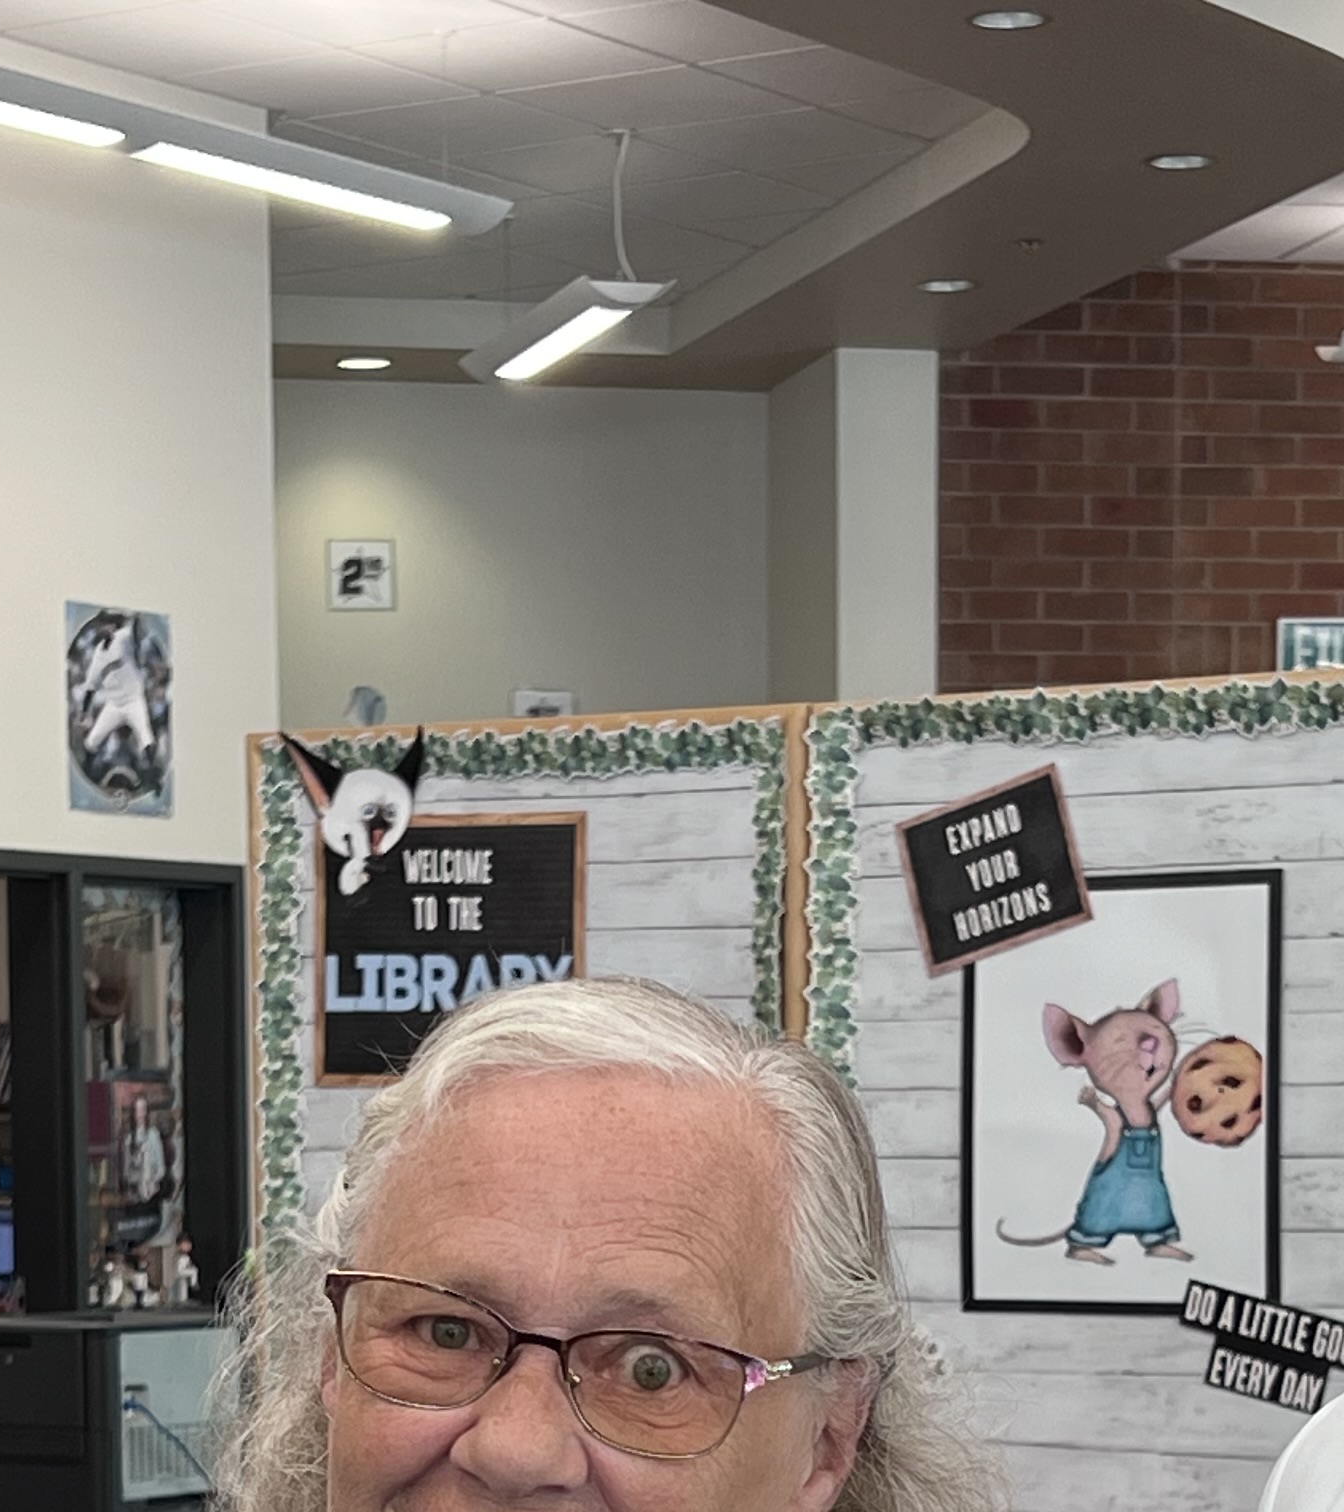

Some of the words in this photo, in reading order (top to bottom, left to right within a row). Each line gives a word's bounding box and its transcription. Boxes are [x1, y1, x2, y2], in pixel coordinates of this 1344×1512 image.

[945, 803, 1022, 856] EXPAND
[403, 849, 494, 884] WELCOME
[965, 849, 1021, 892] YOUR
[412, 895, 439, 931] TO
[447, 895, 483, 931] THE
[953, 882, 1052, 941] HORIZONS
[1184, 1284, 1217, 1326] DO
[1217, 1295, 1235, 1332] A
[1238, 1299, 1312, 1353] LITTLE
[1209, 1349, 1279, 1399] EVERY
[1280, 1367, 1323, 1414] DAY
